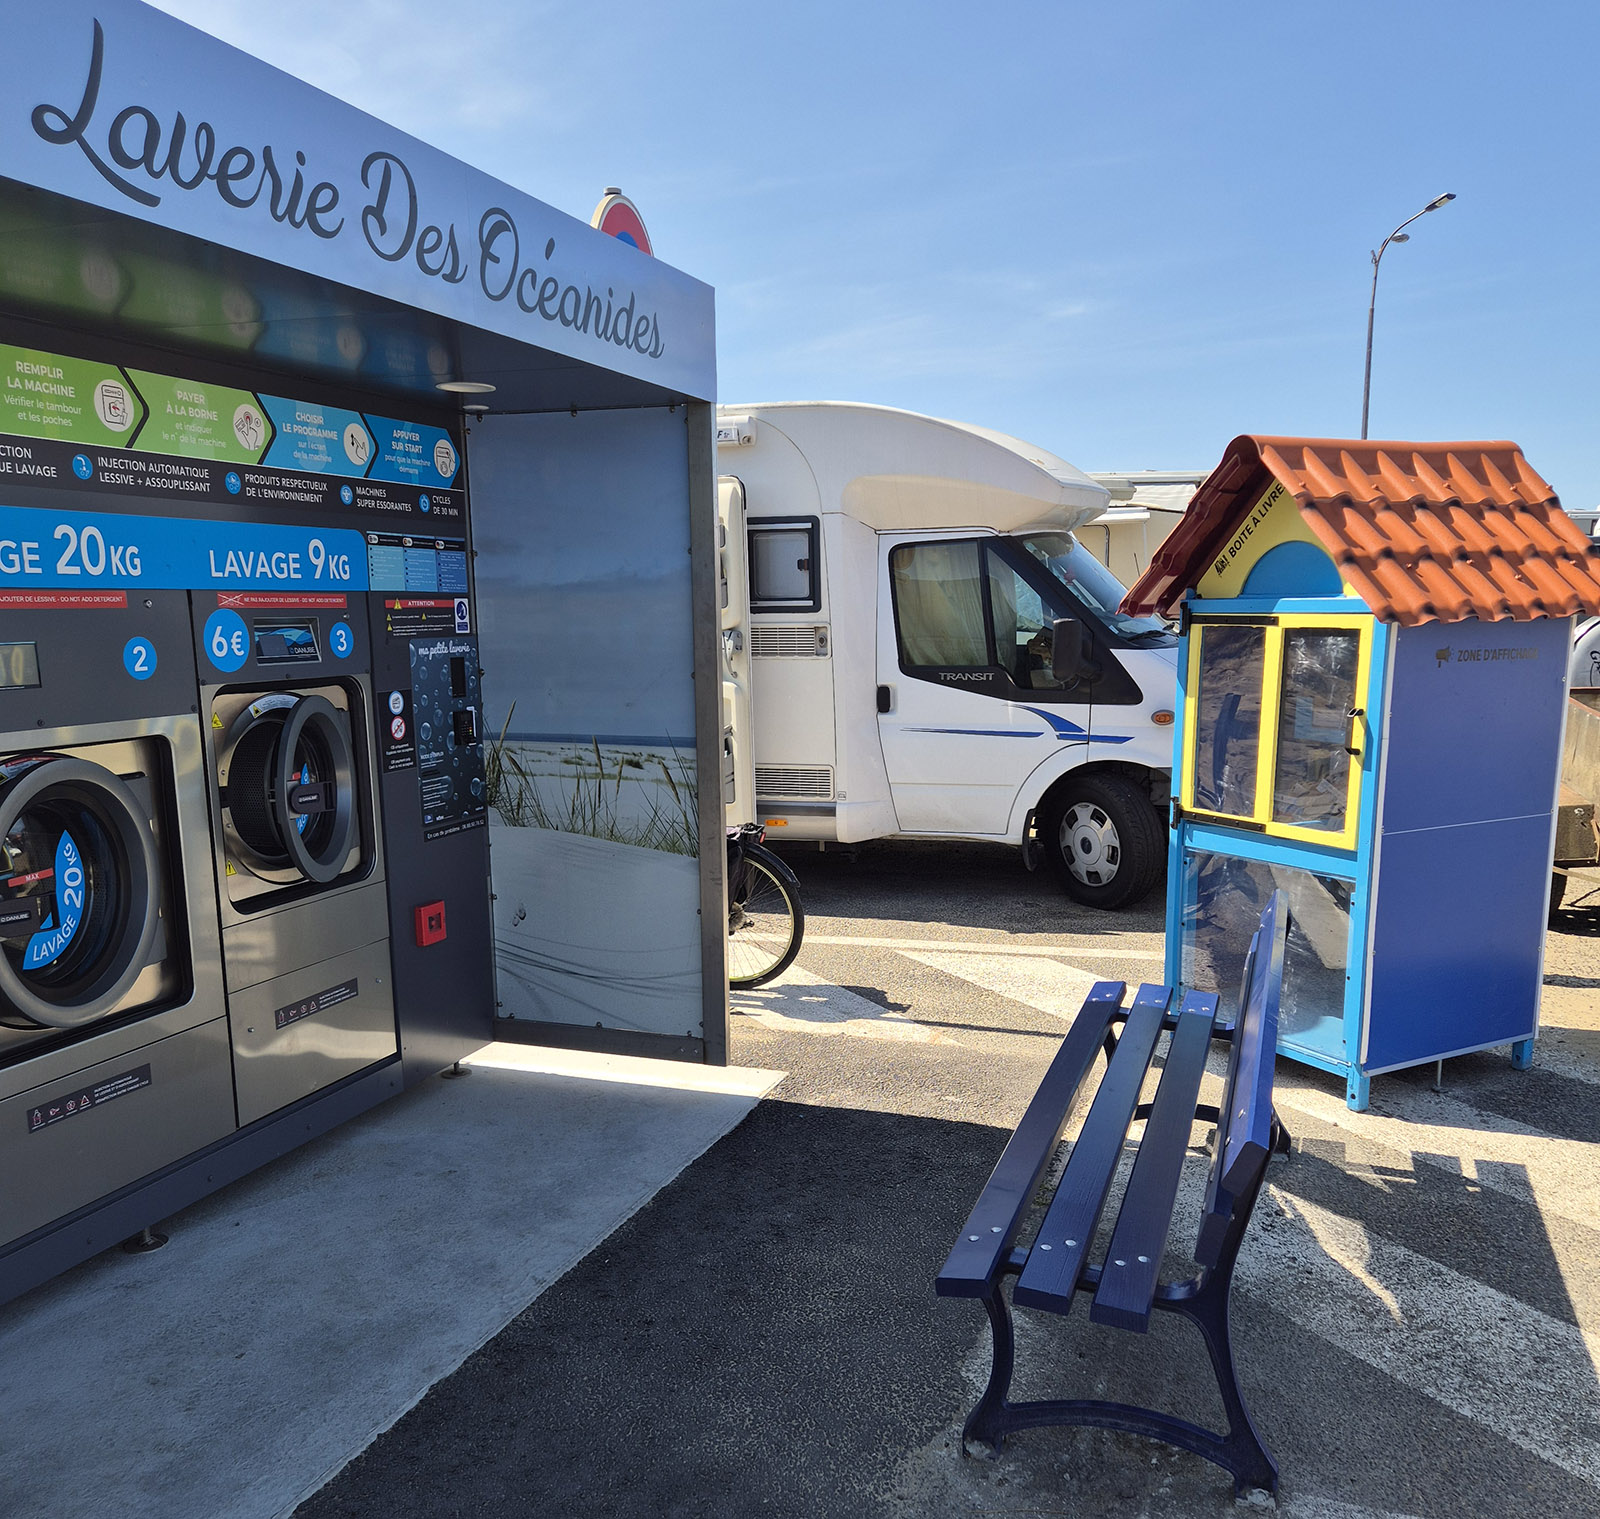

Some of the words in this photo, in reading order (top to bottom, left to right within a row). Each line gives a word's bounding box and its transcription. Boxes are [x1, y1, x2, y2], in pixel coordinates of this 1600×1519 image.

[31, 18, 344, 239] Laverie
[360, 151, 467, 283] Des
[478, 207, 664, 359] Océanides
[16, 360, 64, 380] REMPLIR
[7, 376, 22, 389] LA
[25, 379, 76, 398] MACHINE
[4, 394, 34, 408] Vérifier
[36, 399, 44, 409] le
[46, 401, 82, 414] tambour
[177, 390, 205, 404] PAYER
[166, 400, 174, 414] À
[175, 405, 186, 416] LA
[188, 407, 218, 421] BORNE
[296, 412, 324, 424] CHOISIR
[18, 412, 27, 420] et
[29, 412, 40, 422] les
[42, 416, 72, 427] poches
[282, 423, 292, 432] LE
[293, 424, 338, 440] PROGRAMME
[393, 430, 420, 441] APPUYER
[0, 444, 32, 458] CTION
[392, 441, 404, 451] SUR
[405, 444, 422, 454] START
[16, 463, 58, 478] LAVAGE
[98, 456, 146, 472] INJECTION
[148, 463, 210, 478] AUTOMATIQUE
[100, 472, 134, 485] LESSIVE
[146, 477, 210, 492] ASSOUPLISSANT
[245, 474, 280, 486] PRODUITS
[282, 478, 328, 491] RESPECTUEUX
[246, 487, 256, 496] DE
[258, 488, 322, 503] L'ENVIRONNEMENT
[356, 486, 386, 498] MACHINES
[432, 496, 450, 504] CYCLES
[357, 498, 375, 508] SUPER
[376, 500, 412, 512] ESSORANTES
[433, 506, 440, 514] DE
[448, 508, 458, 516] MIN
[1228, 524, 1254, 558] BOITE
[1250, 514, 1260, 528] À
[1258, 483, 1286, 518] LIVRE
[0, 540, 42, 574] GE
[209, 549, 302, 579] LAVAGE
[336, 630, 346, 652] 3
[132, 646, 148, 672] 2
[1458, 649, 1482, 662] ZONE
[938, 672, 994, 680] TRANSIT
[26, 873, 40, 882] MAX
[33, 914, 76, 962] LAVAGE
